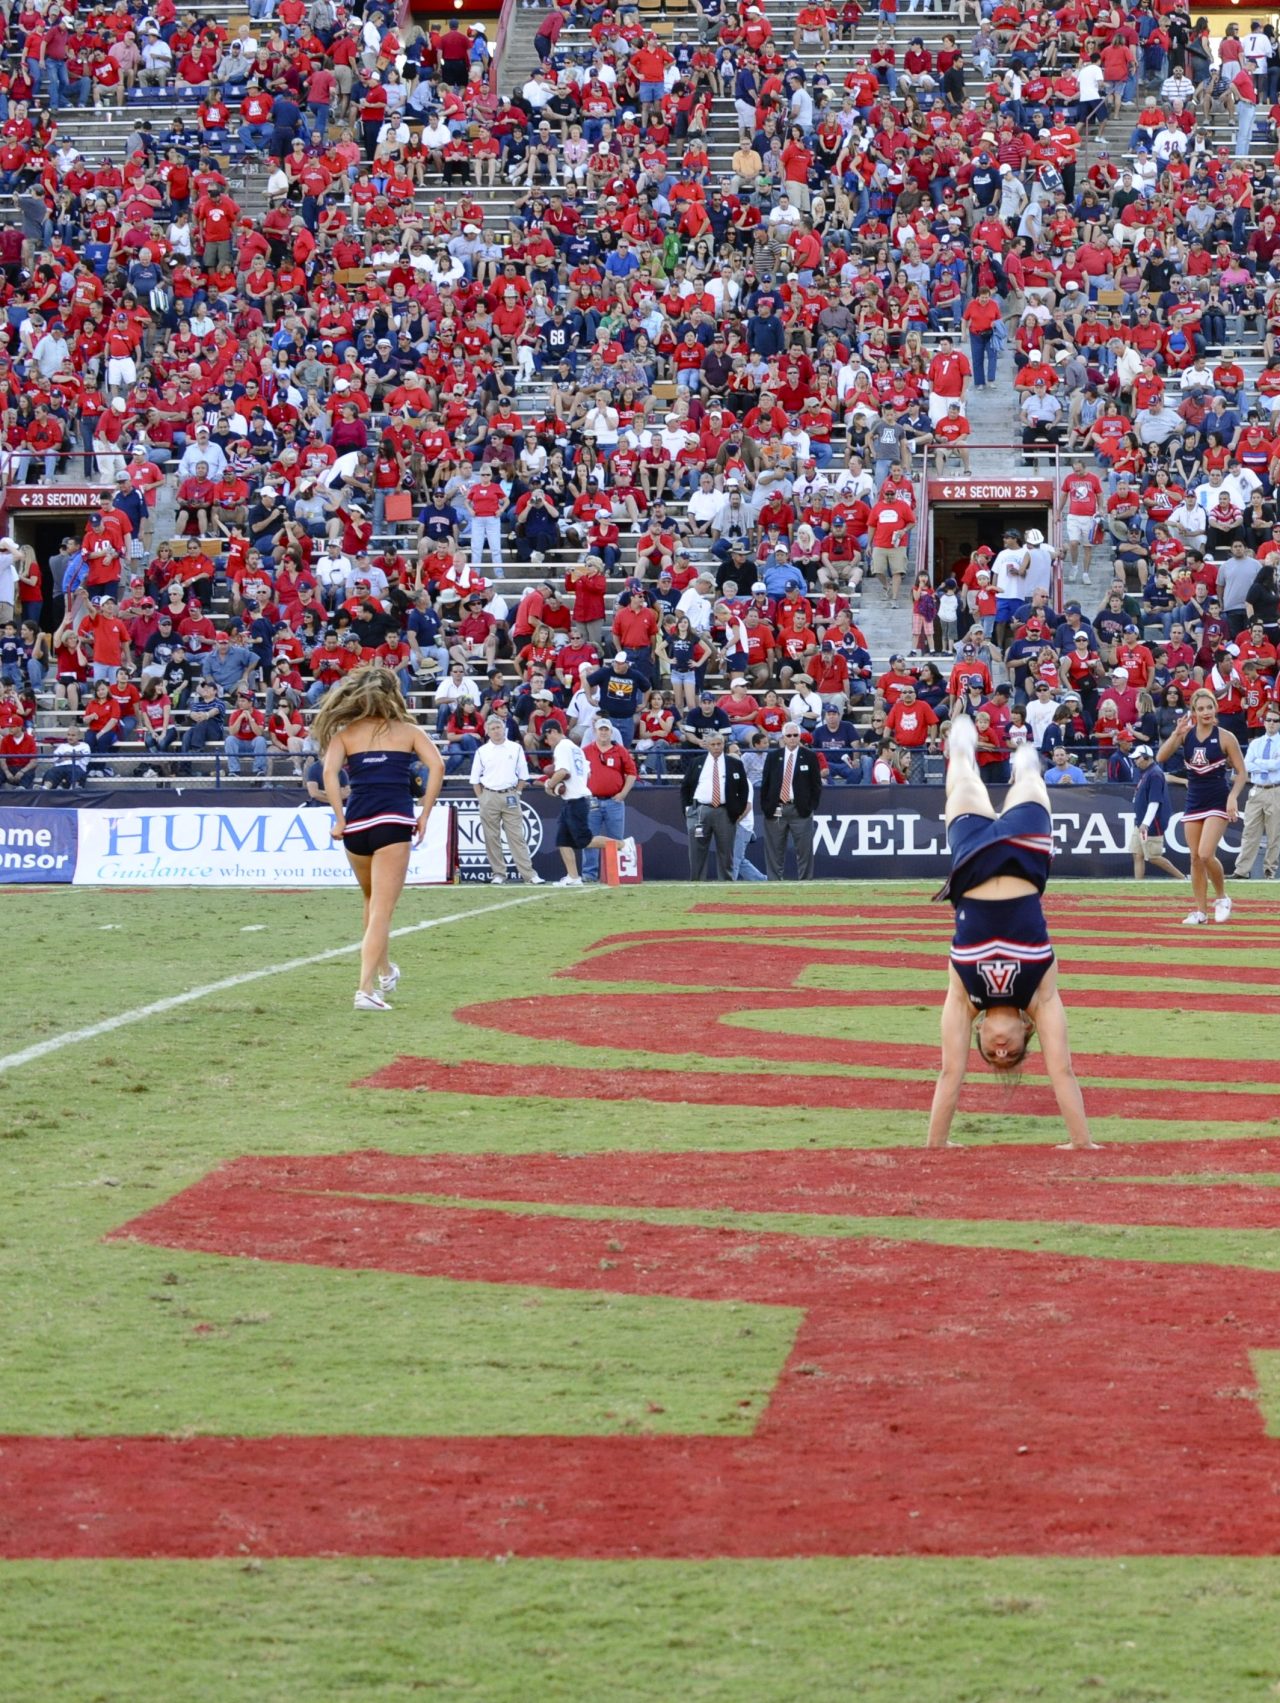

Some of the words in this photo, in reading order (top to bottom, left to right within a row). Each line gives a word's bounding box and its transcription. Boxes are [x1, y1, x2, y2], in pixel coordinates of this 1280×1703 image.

[550, 329, 566, 346] 68
[32, 493, 44, 506] 23
[47, 493, 88, 506] SECTION
[90, 493, 101, 506] 24
[954, 485, 966, 498] 24
[970, 485, 1012, 498] SECTION
[1015, 485, 1027, 498] 25
[1190, 746, 1210, 766] A
[103, 813, 420, 857] HUMA
[97, 856, 213, 879] Guidance
[219, 863, 266, 878] when
[273, 867, 309, 881] you
[463, 872, 494, 880] YAQU
